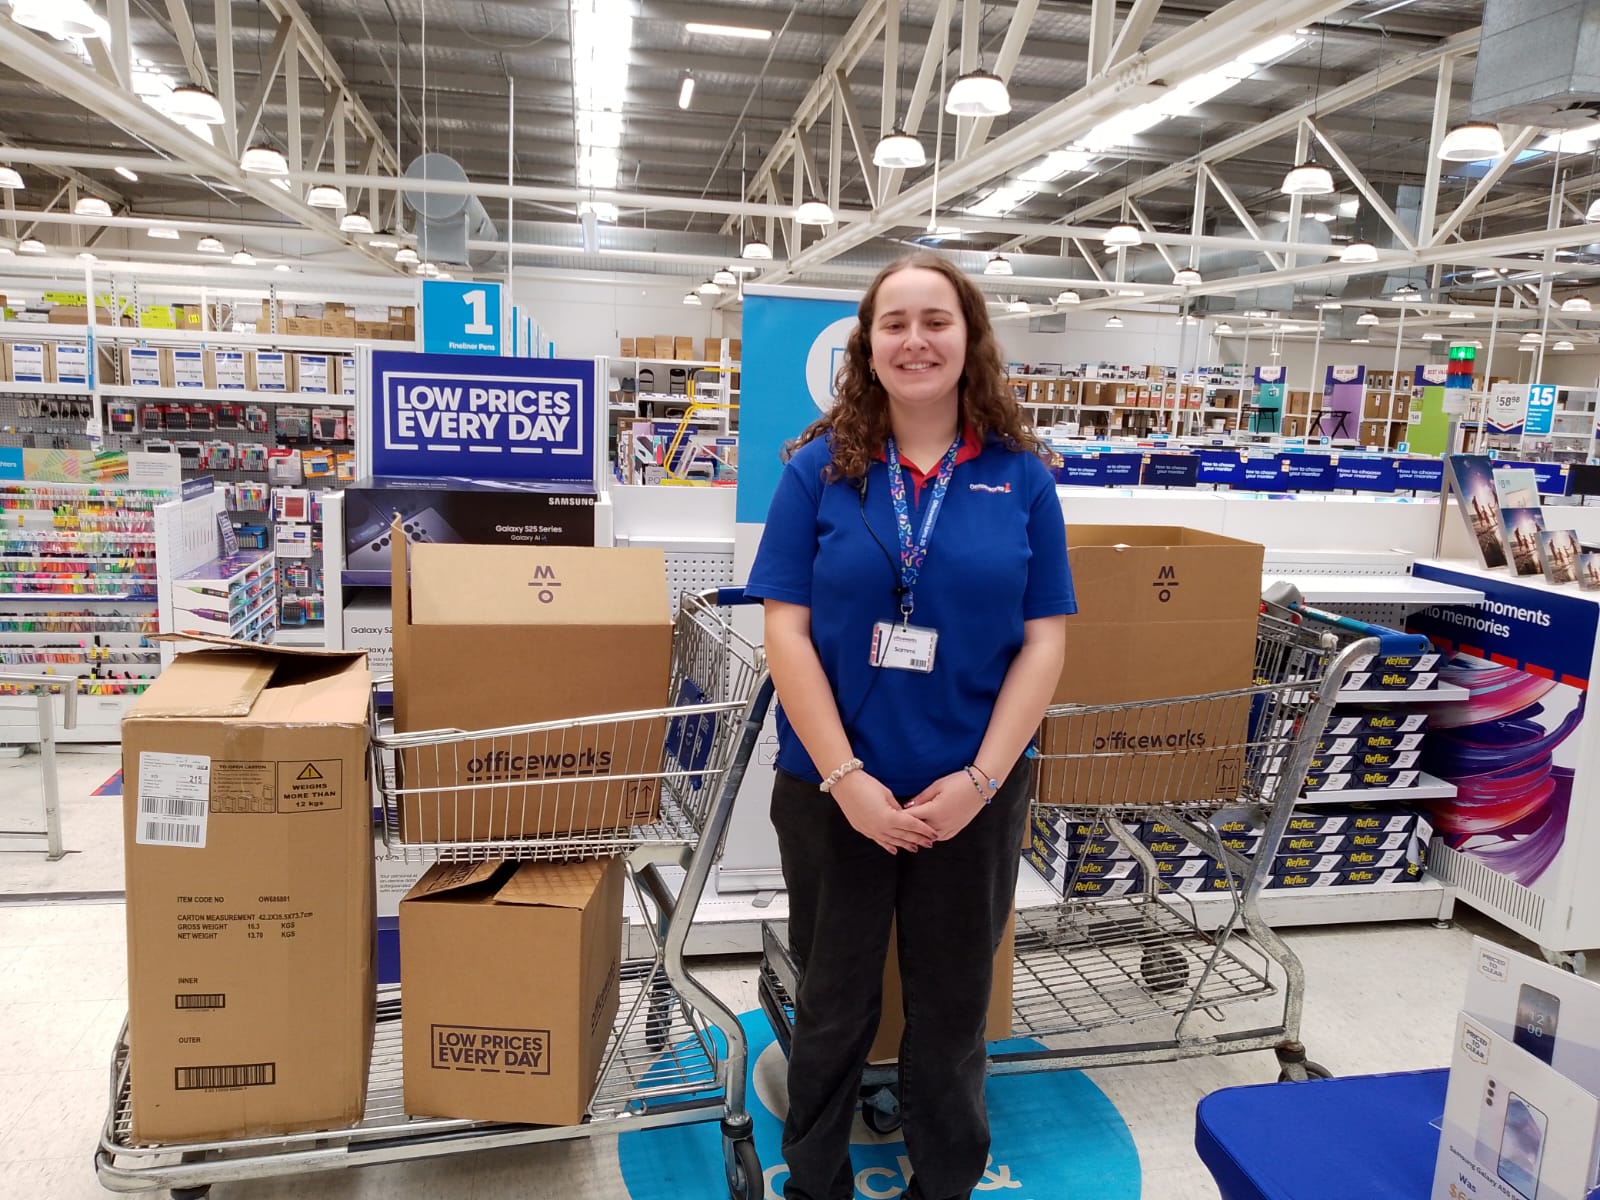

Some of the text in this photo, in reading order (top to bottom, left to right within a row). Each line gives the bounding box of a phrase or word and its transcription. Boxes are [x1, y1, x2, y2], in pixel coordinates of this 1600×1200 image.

[463, 289, 493, 335] 1
[449, 341, 495, 352] Fineliner Pens
[397, 385, 571, 416] LOW PRICES
[1530, 387, 1554, 406] 15
[398, 410, 571, 443] EVERY DAY
[548, 497, 594, 506] SAMSUNG
[495, 525, 563, 534] Galaxy S25 Series
[510, 534, 534, 542] Galaxy
[533, 565, 556, 579] M
[1158, 566, 1175, 579] M
[538, 589, 555, 604] O
[1158, 589, 1171, 603] O
[1479, 599, 1551, 627] moments
[1420, 606, 1510, 638] nto memories
[350, 626, 393, 635] Galaxy S2
[1382, 674, 1407, 685] Reflex
[1370, 716, 1396, 727] Reflex
[1093, 729, 1206, 751] officeworks
[1368, 736, 1393, 747] Reflex
[467, 748, 611, 773] officeworks
[1365, 752, 1390, 765] Reflex
[1363, 772, 1389, 784] Reflex
[283, 792, 309, 800] MORE
[1290, 819, 1316, 830] Reflex
[1355, 817, 1380, 829] Reflex
[1150, 841, 1177, 852] Reflex
[1289, 838, 1314, 850] Reflex
[1353, 835, 1378, 846] Reflex
[1079, 843, 1105, 854] Rflex
[1285, 857, 1310, 868] Reflex
[1350, 853, 1374, 864] Reflex
[1283, 875, 1309, 885] Reflex
[1348, 871, 1373, 881] Reflex
[1074, 882, 1102, 891] Reflex
[1482, 953, 1506, 966] PRICED
[1489, 961, 1498, 969] TO
[1481, 965, 1503, 977] CLEAR
[178, 1036, 201, 1044] OUTER
[438, 1031, 543, 1052] LOW PRICES
[1466, 1028, 1488, 1047] PRICED
[1472, 1039, 1480, 1048] TO
[439, 1046, 543, 1068] EVERY DAY
[1449, 1145, 1476, 1171] Samsung
[1476, 1166, 1498, 1188] Galaxy
[1459, 1172, 1477, 1193] Was
